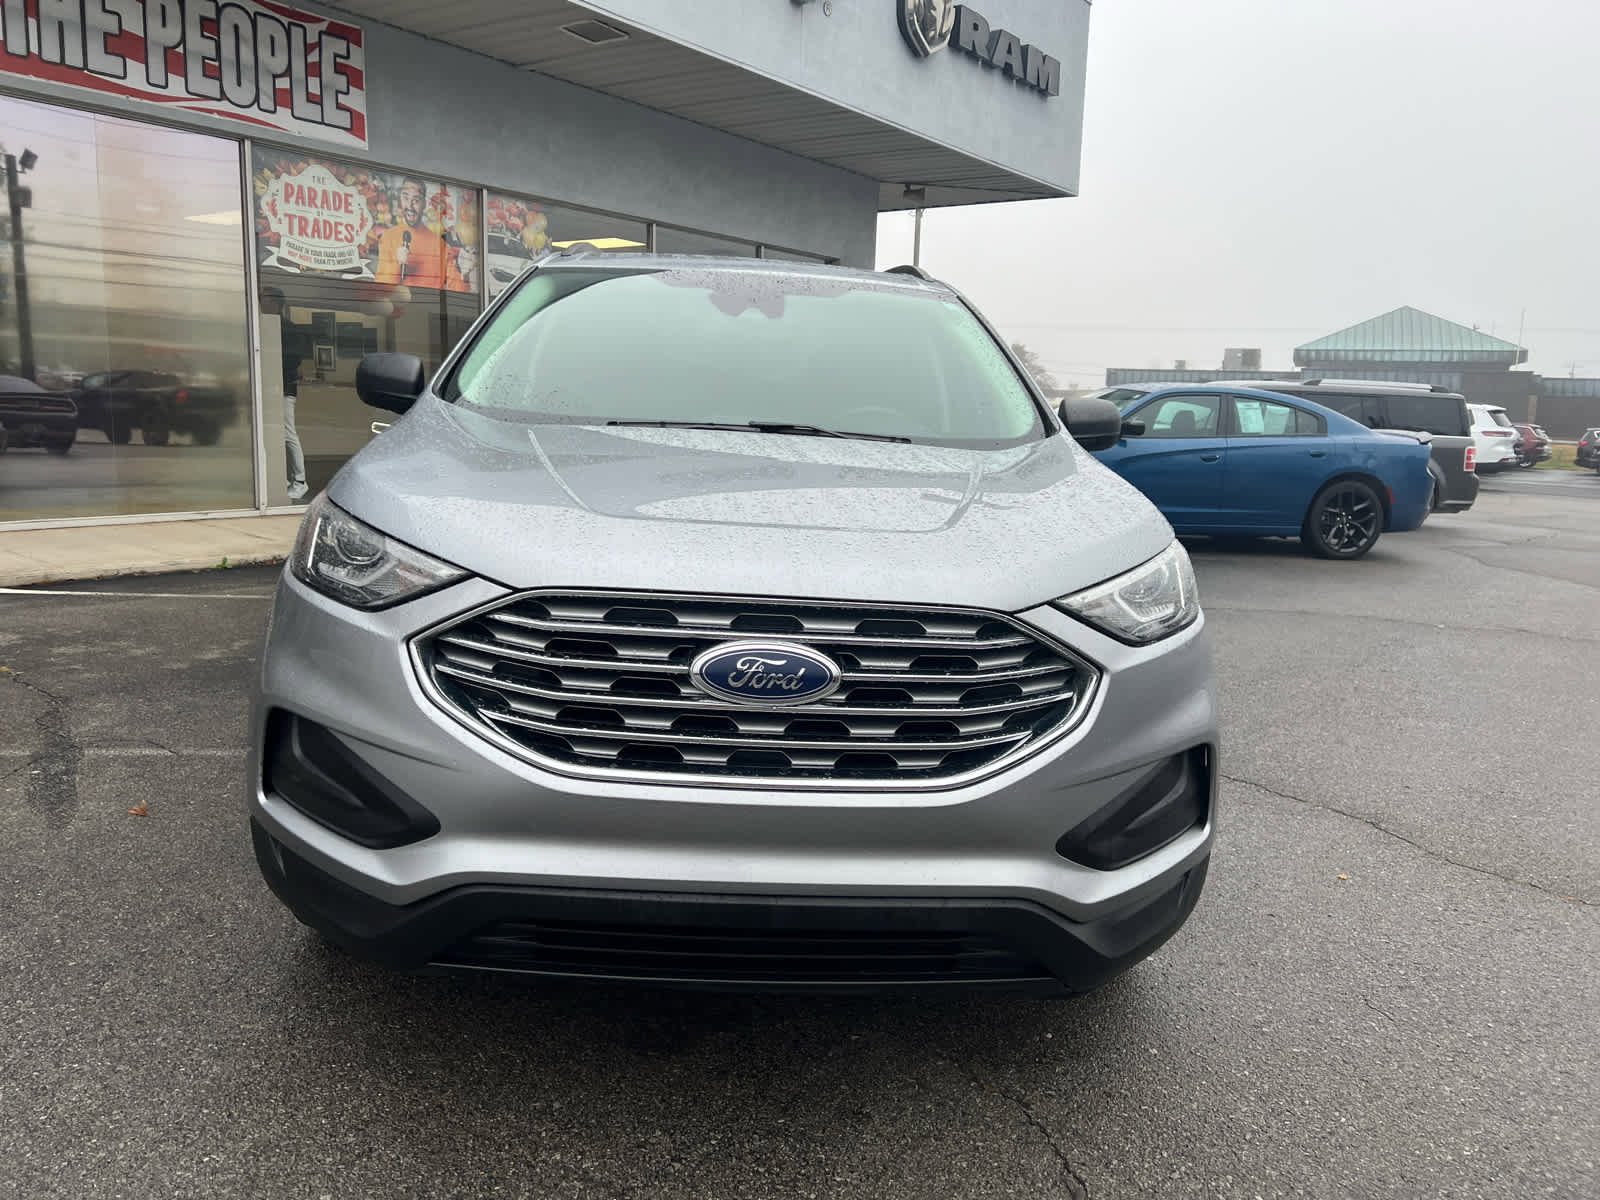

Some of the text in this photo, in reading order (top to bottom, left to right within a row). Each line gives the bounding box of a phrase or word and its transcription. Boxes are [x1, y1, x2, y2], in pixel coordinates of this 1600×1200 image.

[143, 0, 352, 130] PEOPLE
[948, 4, 1060, 97] RAM
[283, 181, 354, 214] PARADE
[283, 212, 355, 243] TRADES
[727, 657, 806, 690] Ford
